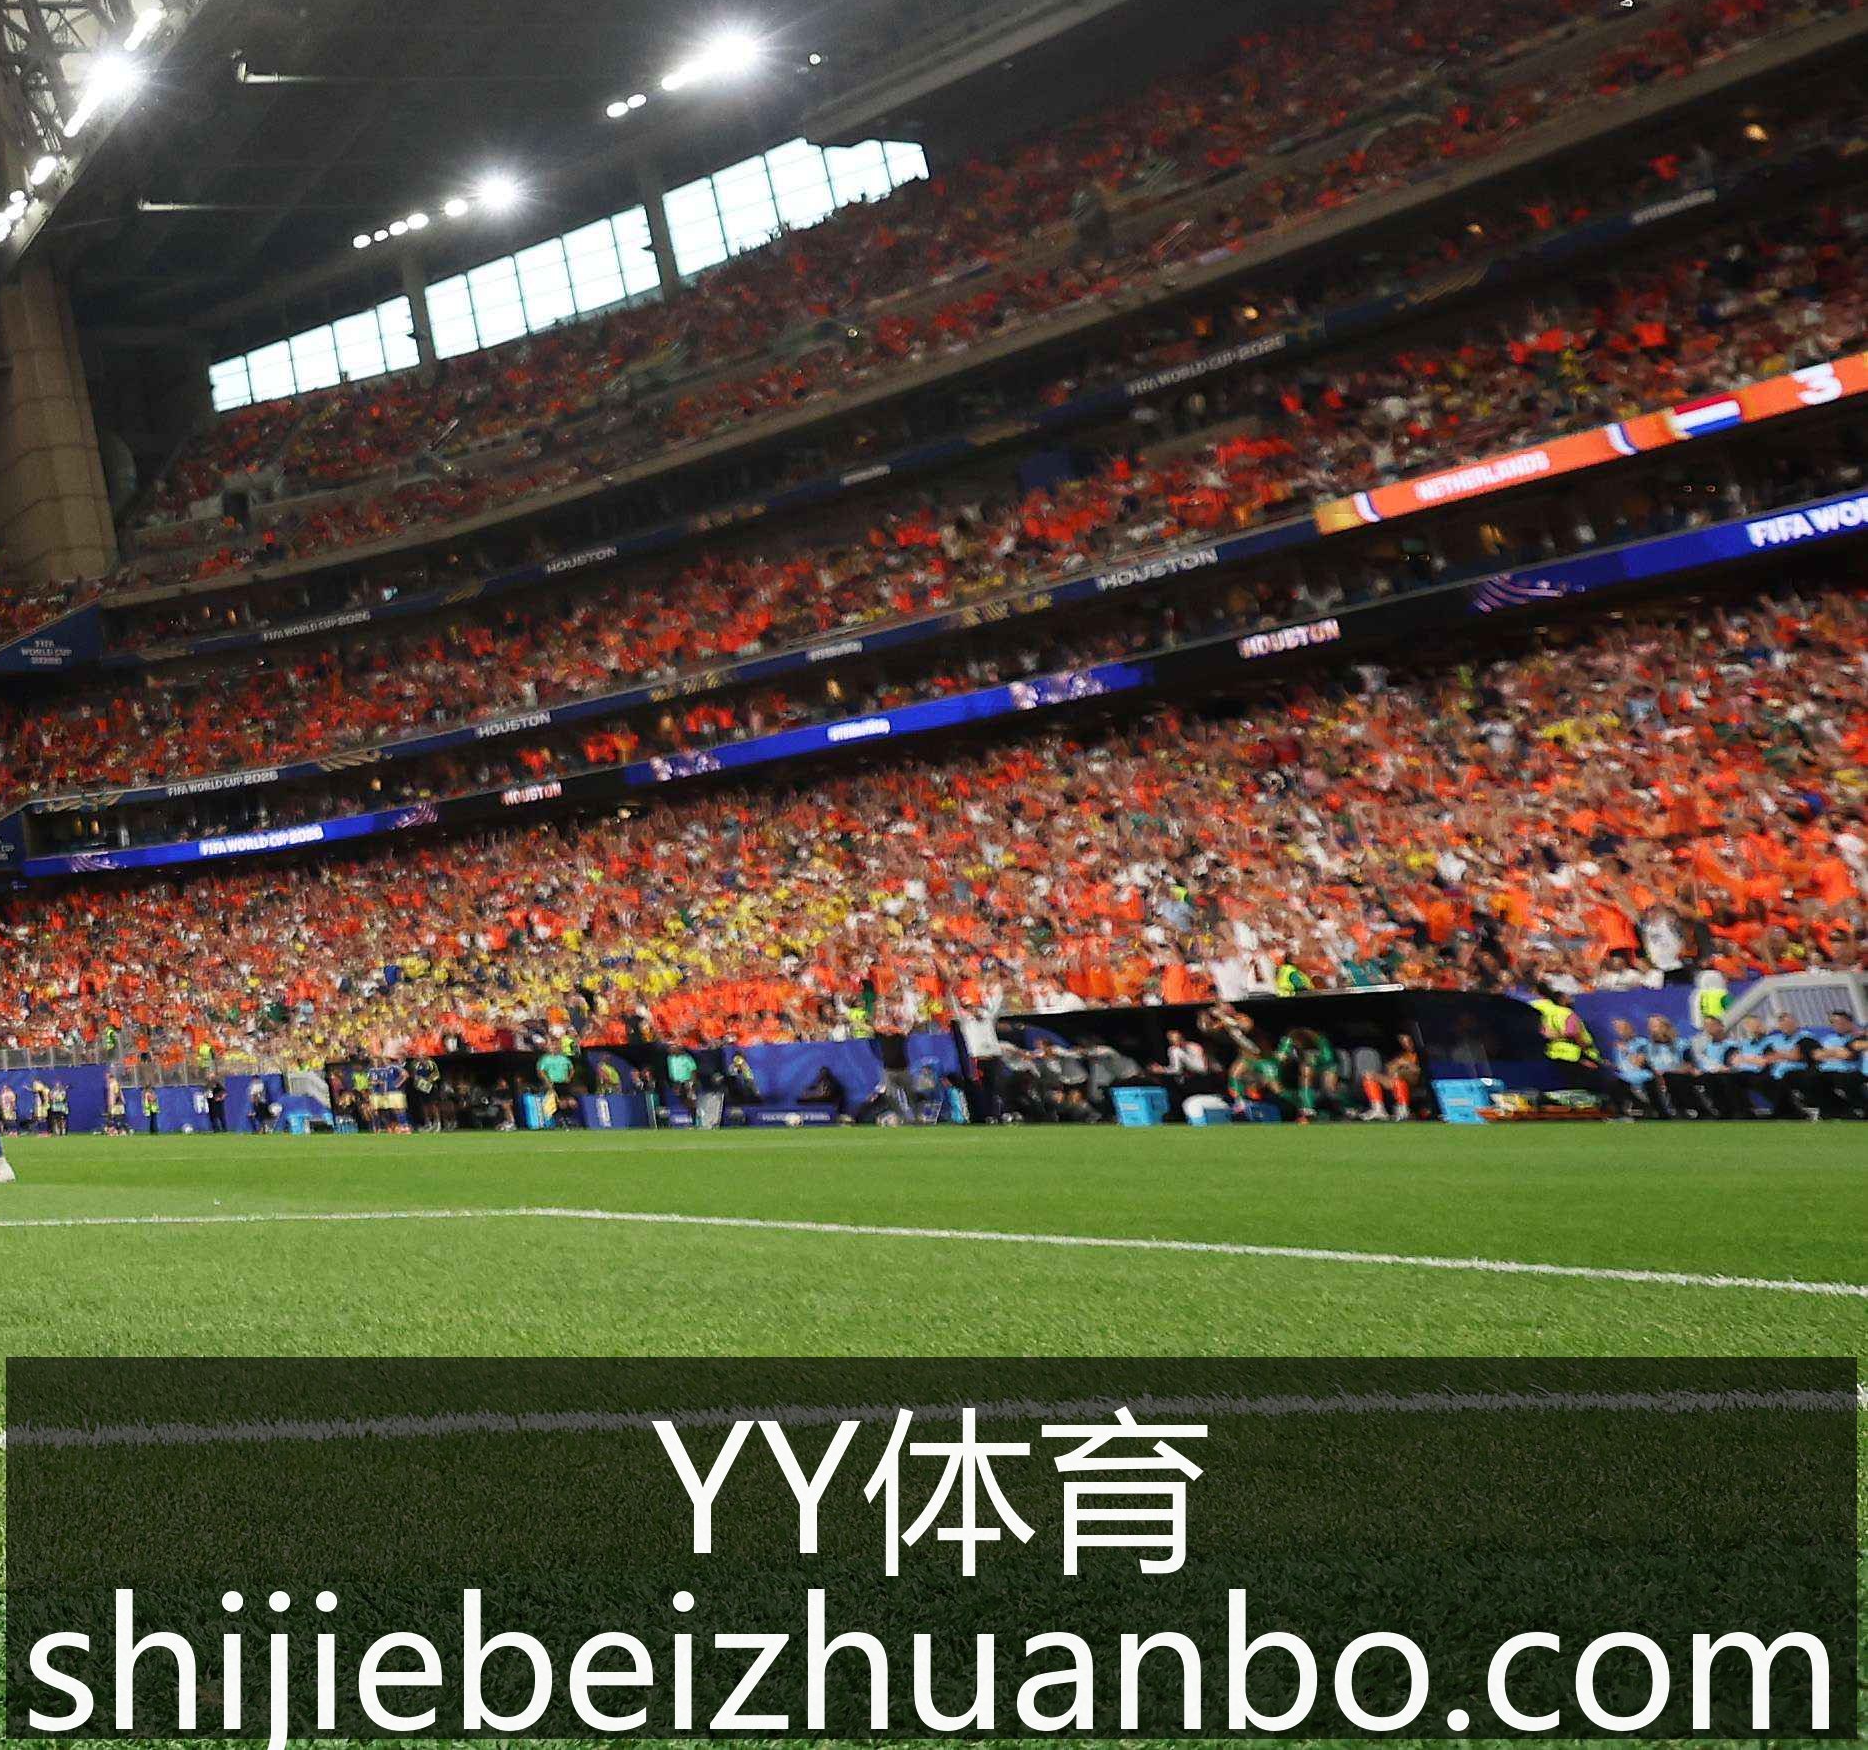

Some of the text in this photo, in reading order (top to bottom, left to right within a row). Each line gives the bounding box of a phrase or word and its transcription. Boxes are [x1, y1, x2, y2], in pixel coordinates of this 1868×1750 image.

[1792, 362, 1844, 405] 3
[1414, 450, 1551, 501] NETHERLANDS
[1746, 512, 1815, 548] FIFA
[547, 546, 618, 574] HOUSTON
[1097, 548, 1218, 592] HOUSTON
[1239, 617, 1341, 659] HOUSTON
[478, 710, 552, 738] HOUSTON
[167, 770, 279, 798] FIFA WORLD CUP 2026
[500, 781, 562, 806] HOUSTON
[200, 825, 324, 857] FIFA WORLD CUP 2026
